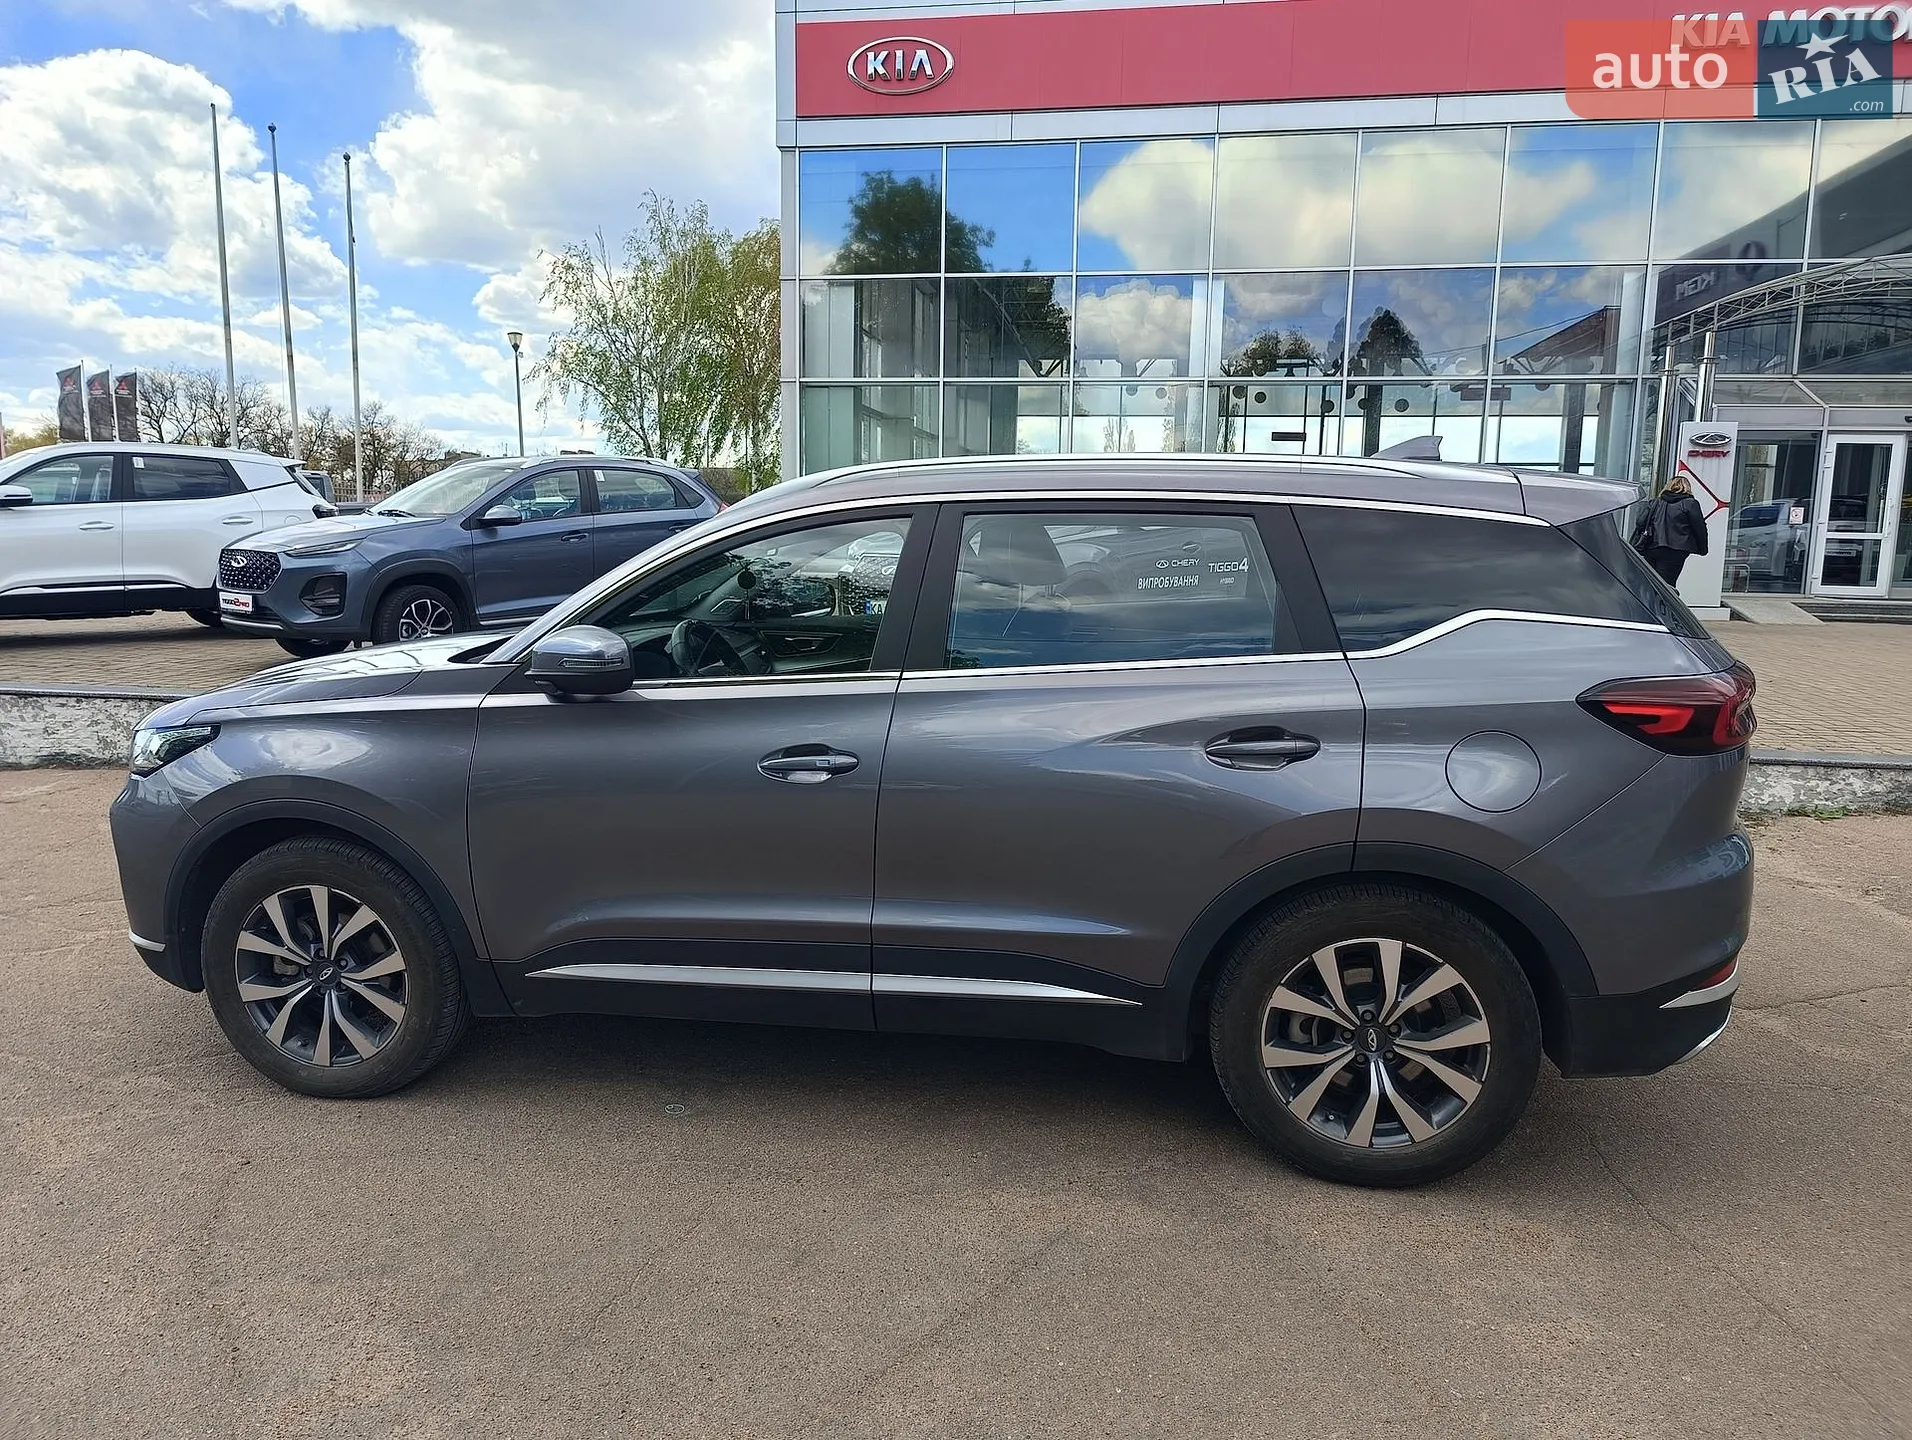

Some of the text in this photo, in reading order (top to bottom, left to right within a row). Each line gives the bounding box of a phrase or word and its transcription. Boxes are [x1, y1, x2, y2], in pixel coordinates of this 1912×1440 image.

[1671, 2, 1912, 48] KIA MOTO
[866, 48, 934, 81] KIA
[1171, 558, 1200, 567] CHERY
[1137, 574, 1200, 590] ВИПРОБУВАННЯ
